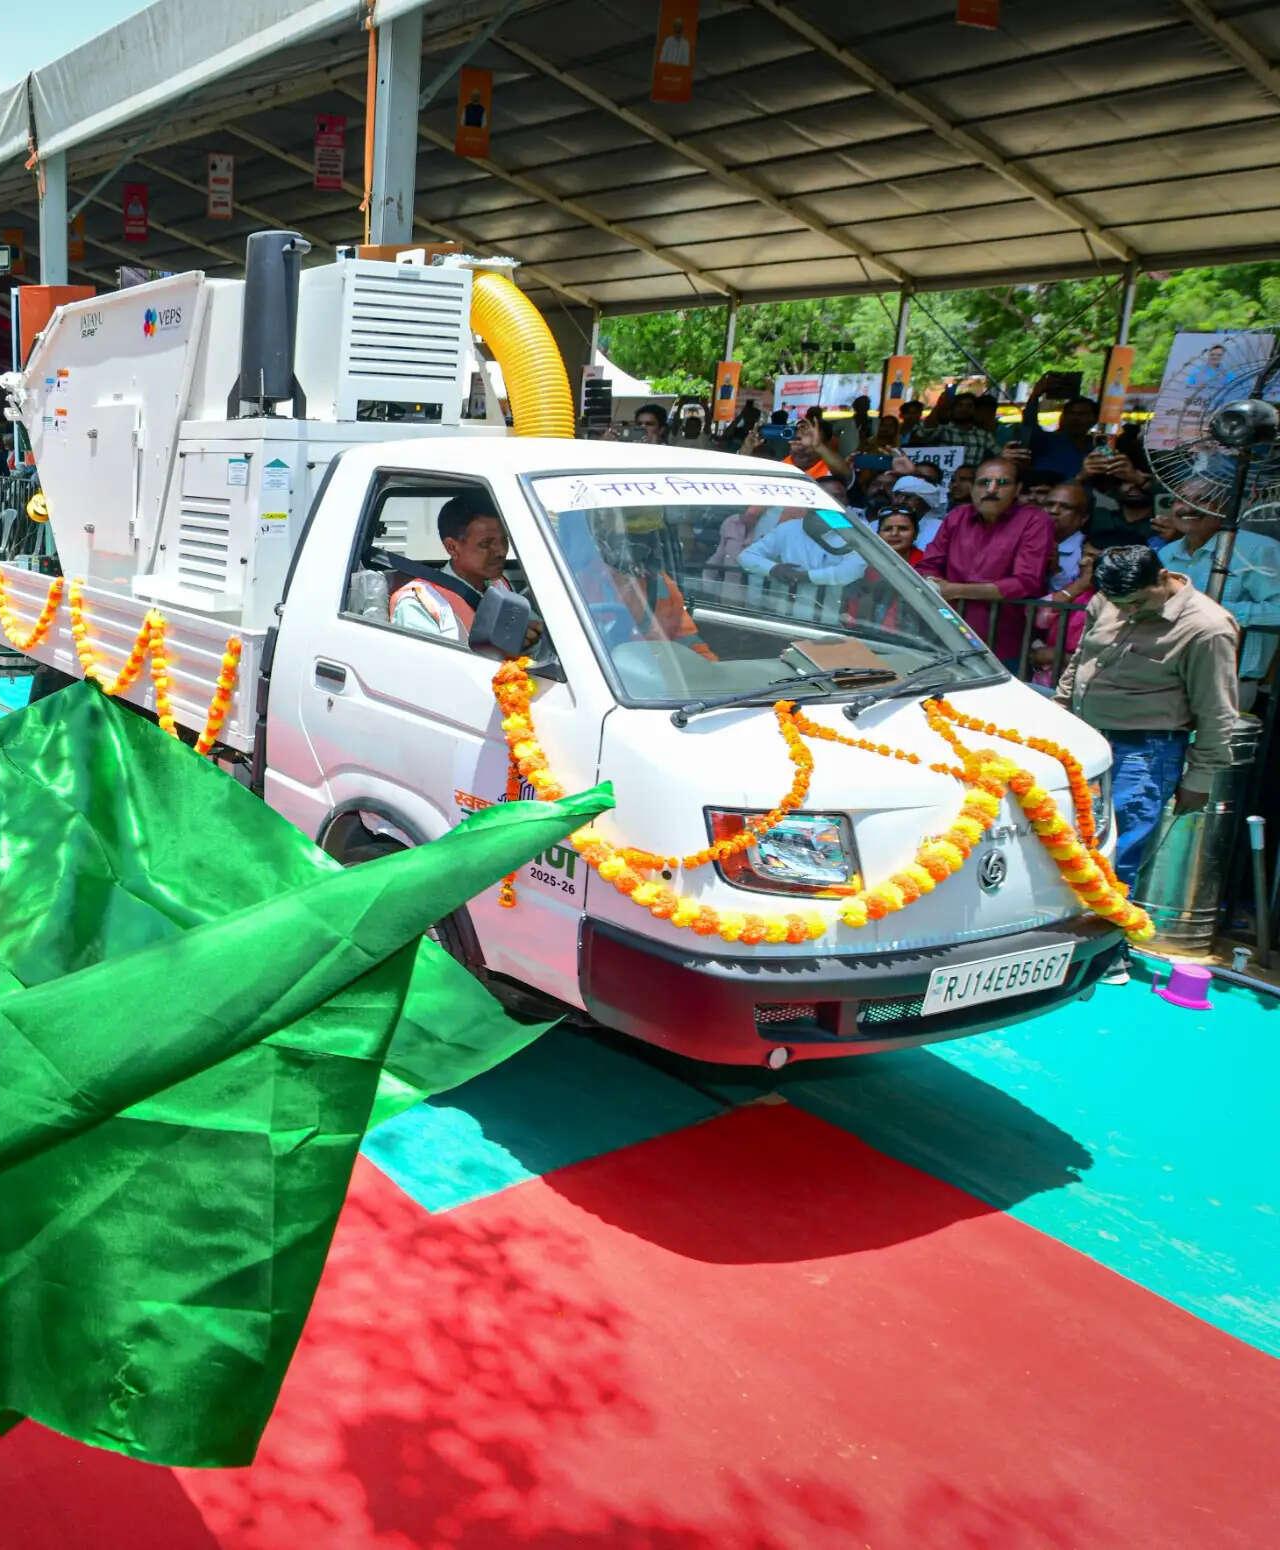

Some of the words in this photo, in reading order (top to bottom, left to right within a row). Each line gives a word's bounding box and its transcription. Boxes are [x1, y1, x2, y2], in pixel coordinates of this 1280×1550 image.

[159, 308, 182, 326] VEPS
[594, 481, 665, 497] नगर
[665, 476, 742, 496] निगम
[530, 866, 576, 896] 2025-26
[943, 952, 1070, 1003] RJ14EB5667
